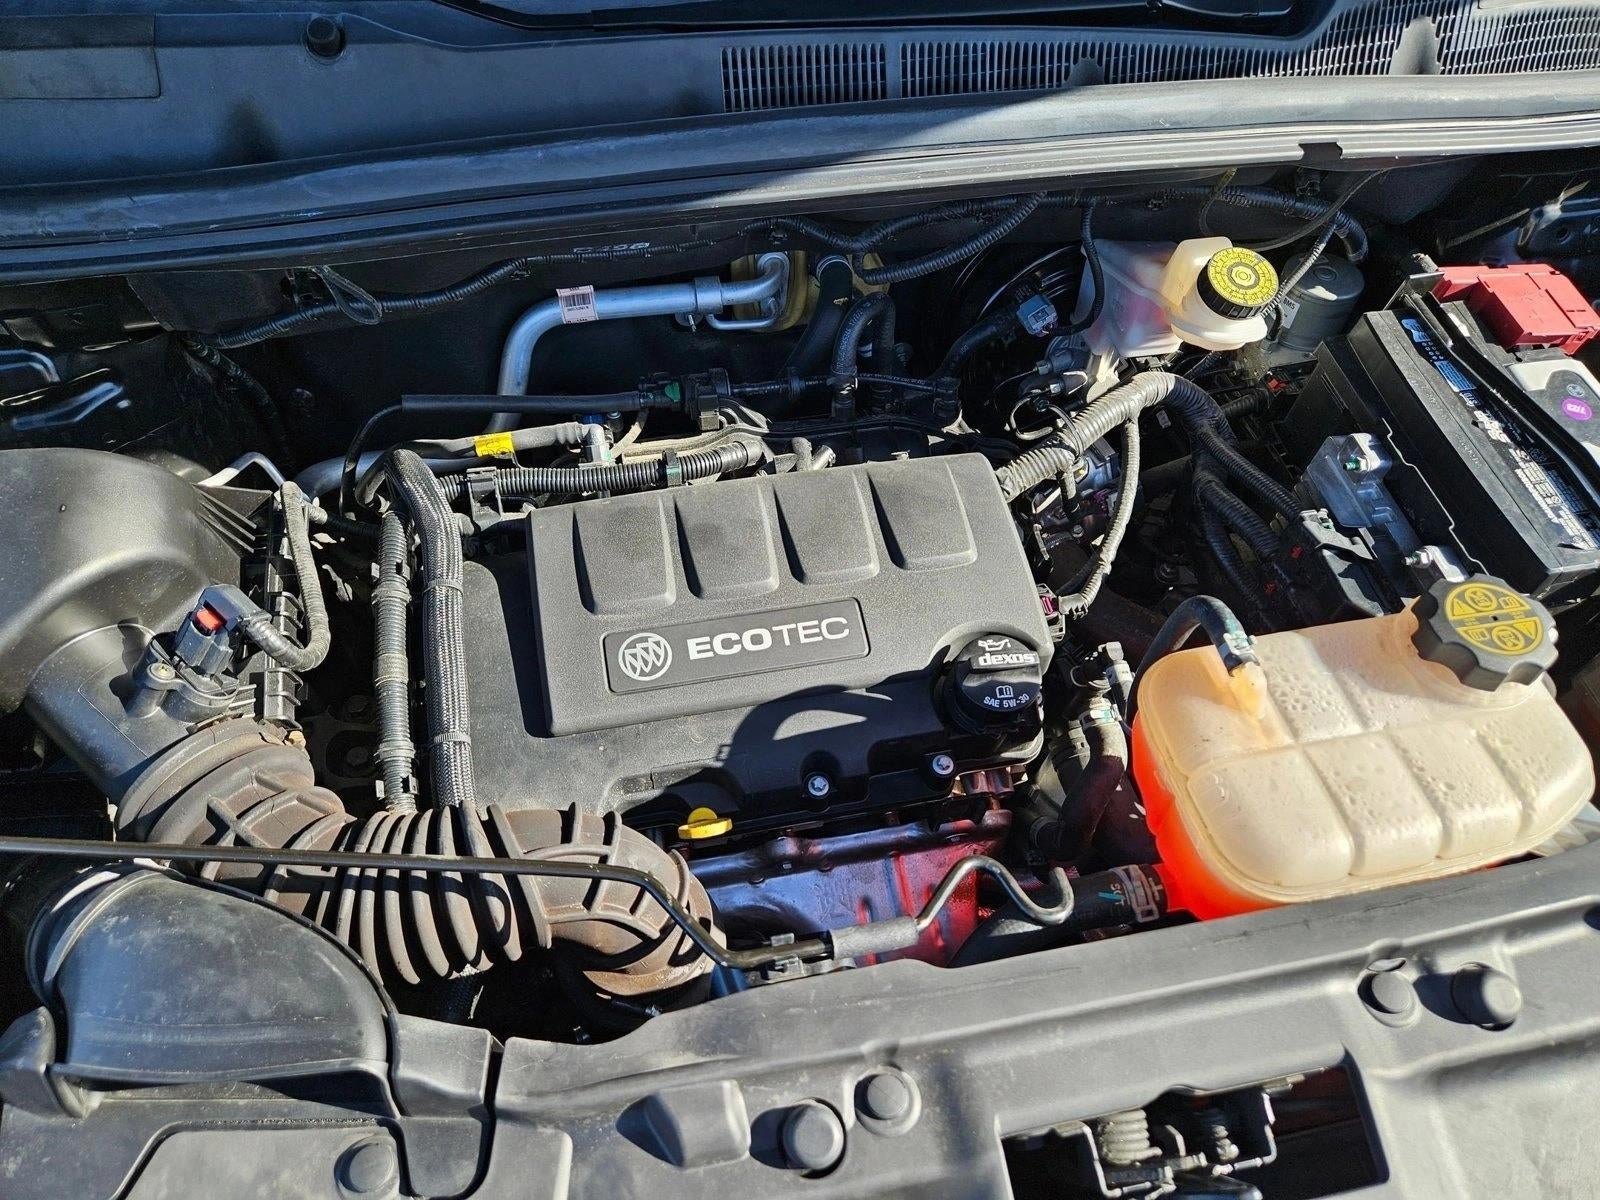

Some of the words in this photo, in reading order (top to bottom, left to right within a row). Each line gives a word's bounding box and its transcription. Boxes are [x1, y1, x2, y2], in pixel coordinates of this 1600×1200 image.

[686, 616, 850, 660] ECOTEC
[978, 652, 1036, 666] dexos
[983, 696, 1000, 708] SAE
[1003, 693, 1030, 708] 5W-30
